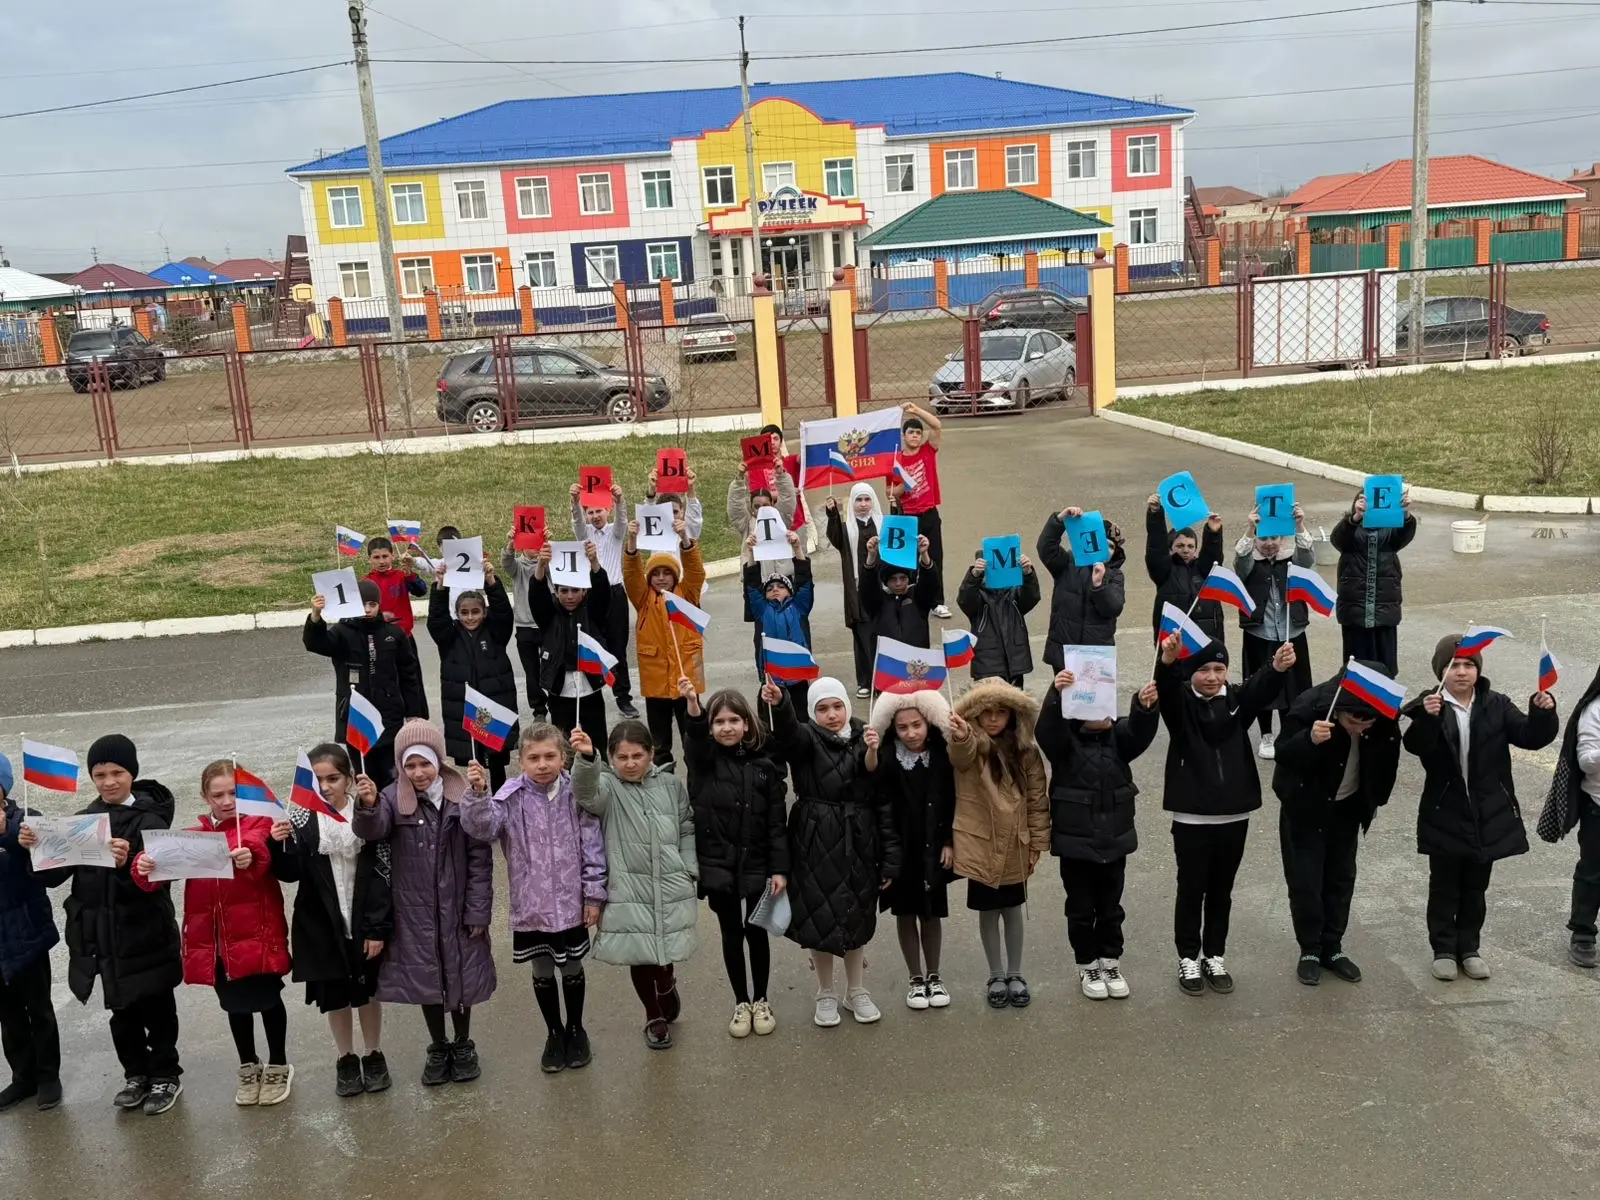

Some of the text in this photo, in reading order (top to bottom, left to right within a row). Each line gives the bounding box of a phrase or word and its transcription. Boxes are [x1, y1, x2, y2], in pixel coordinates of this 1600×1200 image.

[747, 440, 771, 459] М
[662, 457, 687, 478] Ы
[586, 474, 602, 495] Р
[1167, 483, 1192, 509] С
[1262, 494, 1285, 519] Т
[1372, 486, 1393, 510] Е
[518, 513, 538, 535] К
[644, 515, 664, 537] Е
[756, 517, 779, 542] Т
[886, 526, 907, 551] В
[455, 551, 472, 574] 2
[555, 550, 580, 574] Л
[991, 546, 1019, 571] М
[332, 582, 351, 607] 1
